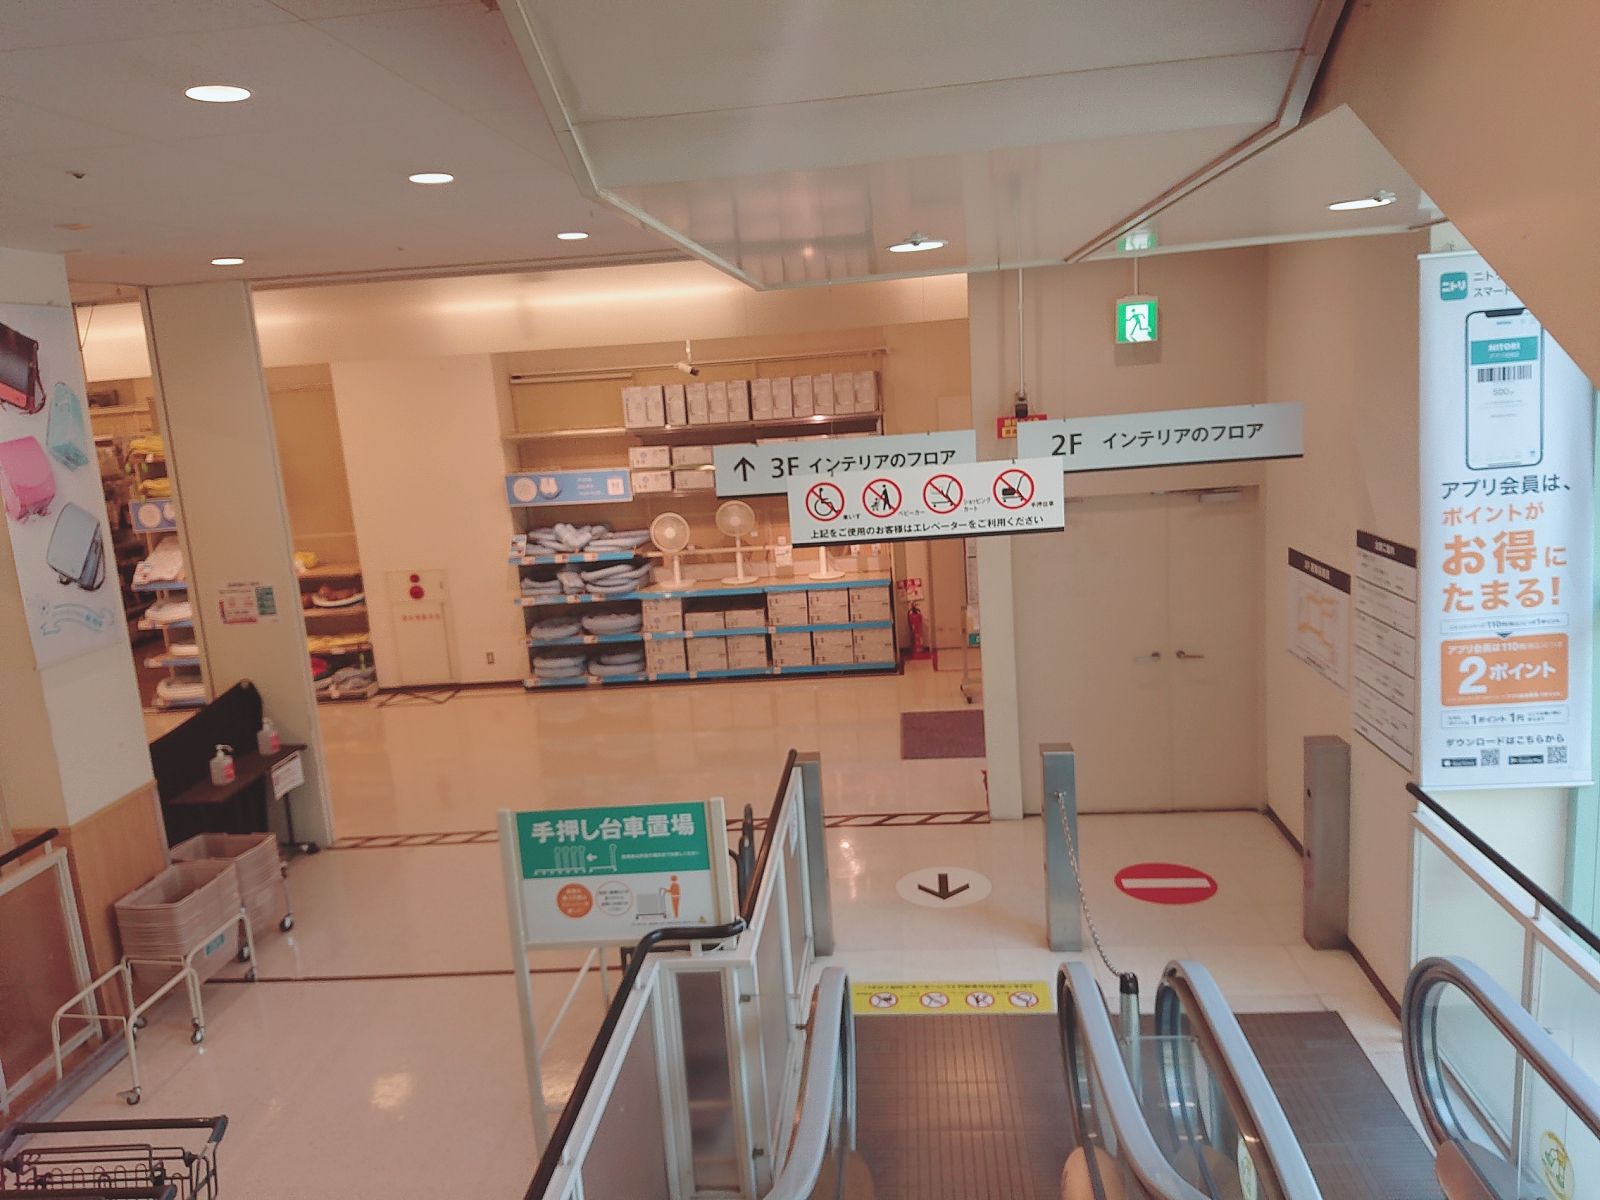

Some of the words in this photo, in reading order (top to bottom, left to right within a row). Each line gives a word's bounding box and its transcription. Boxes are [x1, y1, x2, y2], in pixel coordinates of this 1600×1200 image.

[1488, 342, 1520, 352] NITORI
[1051, 433, 1083, 456] 2F
[1103, 423, 1264, 450] インテリアのフロア
[770, 456, 800, 479] 3F
[809, 450, 956, 474] インテリアのフロア
[1441, 474, 1571, 500] アプリ会員は、
[810, 515, 1044, 539] 上記をご使用のお客様はエレベーターをご利用ください
[1442, 501, 1545, 527] ポイントが
[1441, 529, 1569, 577] お得に
[1446, 733, 1565, 747] ダウンロードはこちらから
[531, 812, 695, 844] 手押し台車置場
